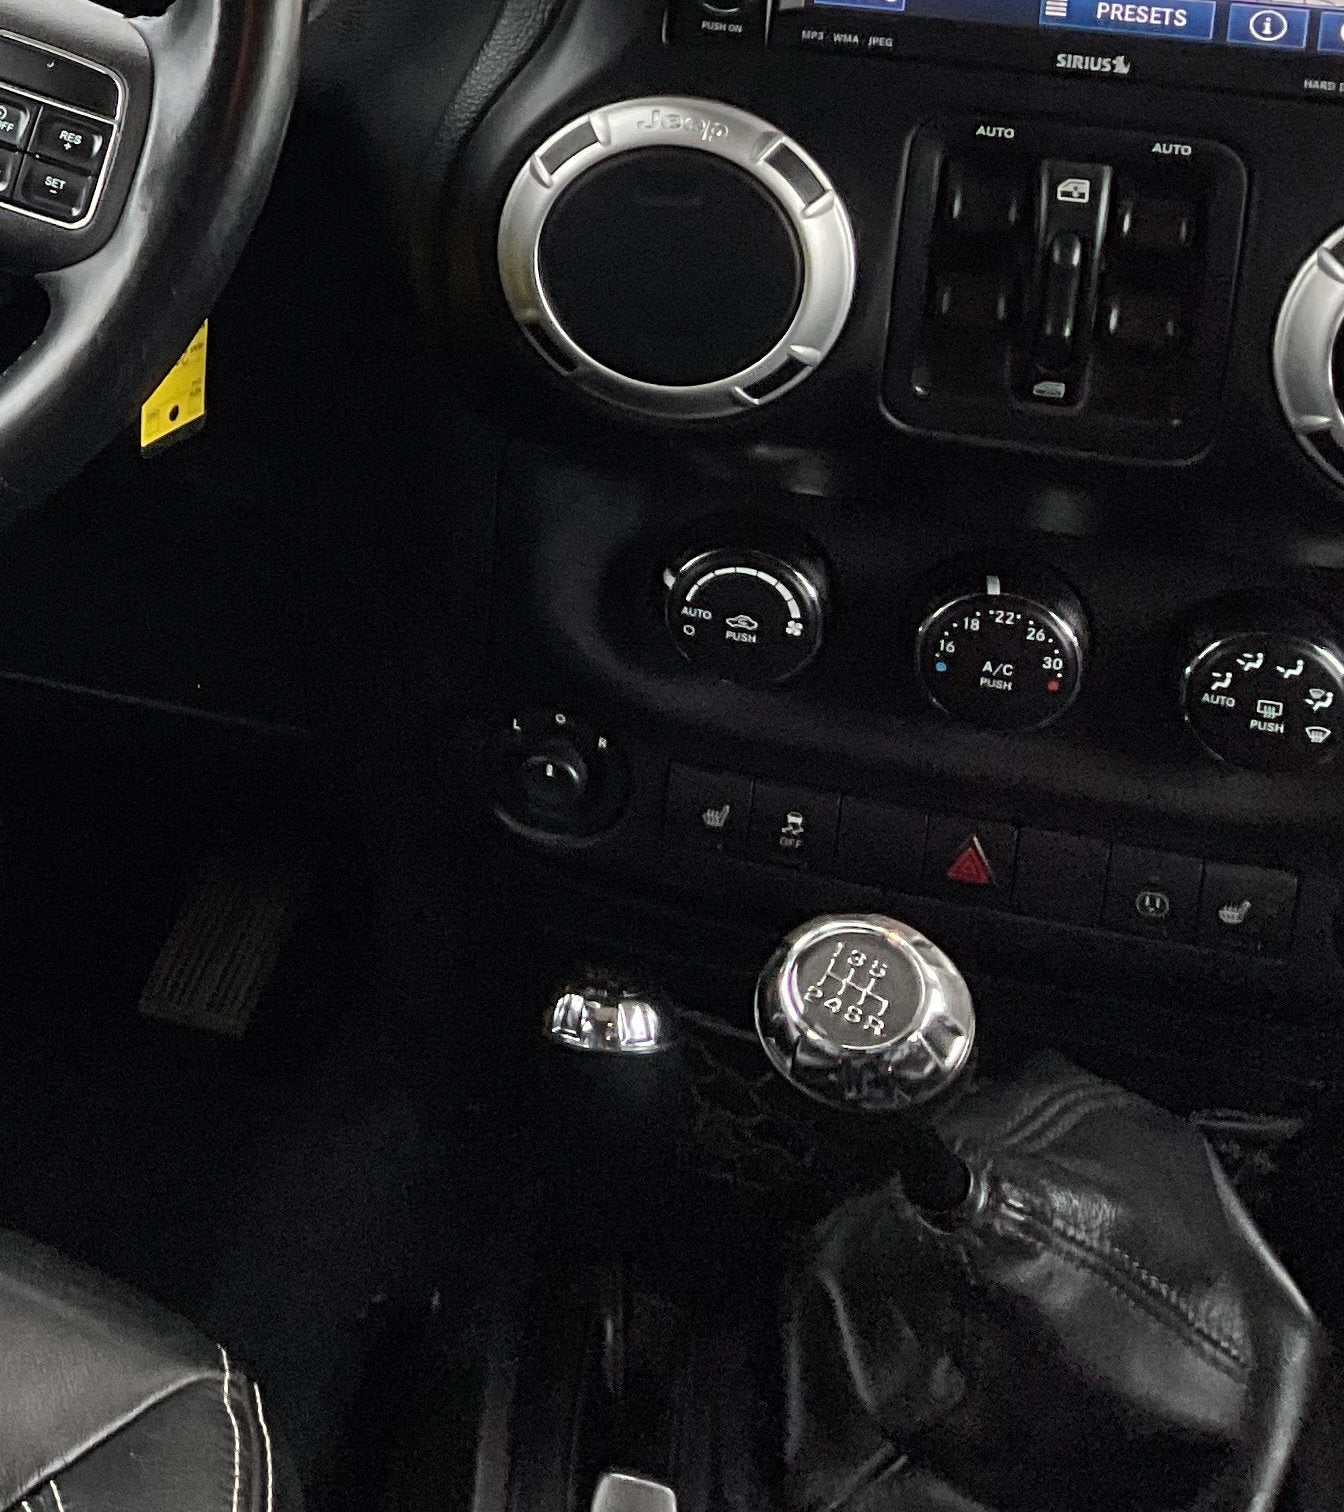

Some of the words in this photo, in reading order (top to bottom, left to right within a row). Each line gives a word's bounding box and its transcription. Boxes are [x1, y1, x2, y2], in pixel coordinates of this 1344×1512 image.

[1096, 1, 1187, 27] PRESETS
[702, 20, 727, 32] PUSH
[728, 23, 743, 34] ON
[801, 29, 824, 41] MP3
[833, 32, 859, 44] WMA
[868, 36, 893, 48] JPEG
[1056, 53, 1112, 73] SIRIUS
[1304, 79, 1336, 92] HARD
[637, 109, 729, 142] Jeep
[975, 125, 1015, 138] AUTO
[59, 130, 83, 145] RES
[1151, 142, 1192, 156] AUTO
[45, 176, 67, 190] SET
[681, 605, 712, 620] AUTO
[995, 610, 1015, 625] 22
[964, 617, 980, 631] 18
[725, 630, 757, 643] PUSH
[1026, 627, 1046, 642] 26
[939, 639, 956, 653] 16
[982, 660, 1014, 677] A/C
[1042, 656, 1063, 671] 30
[979, 676, 1013, 691] PUSH
[1201, 692, 1236, 708] AUTO
[1249, 719, 1285, 734] PUSH
[863, 1014, 885, 1035] R
